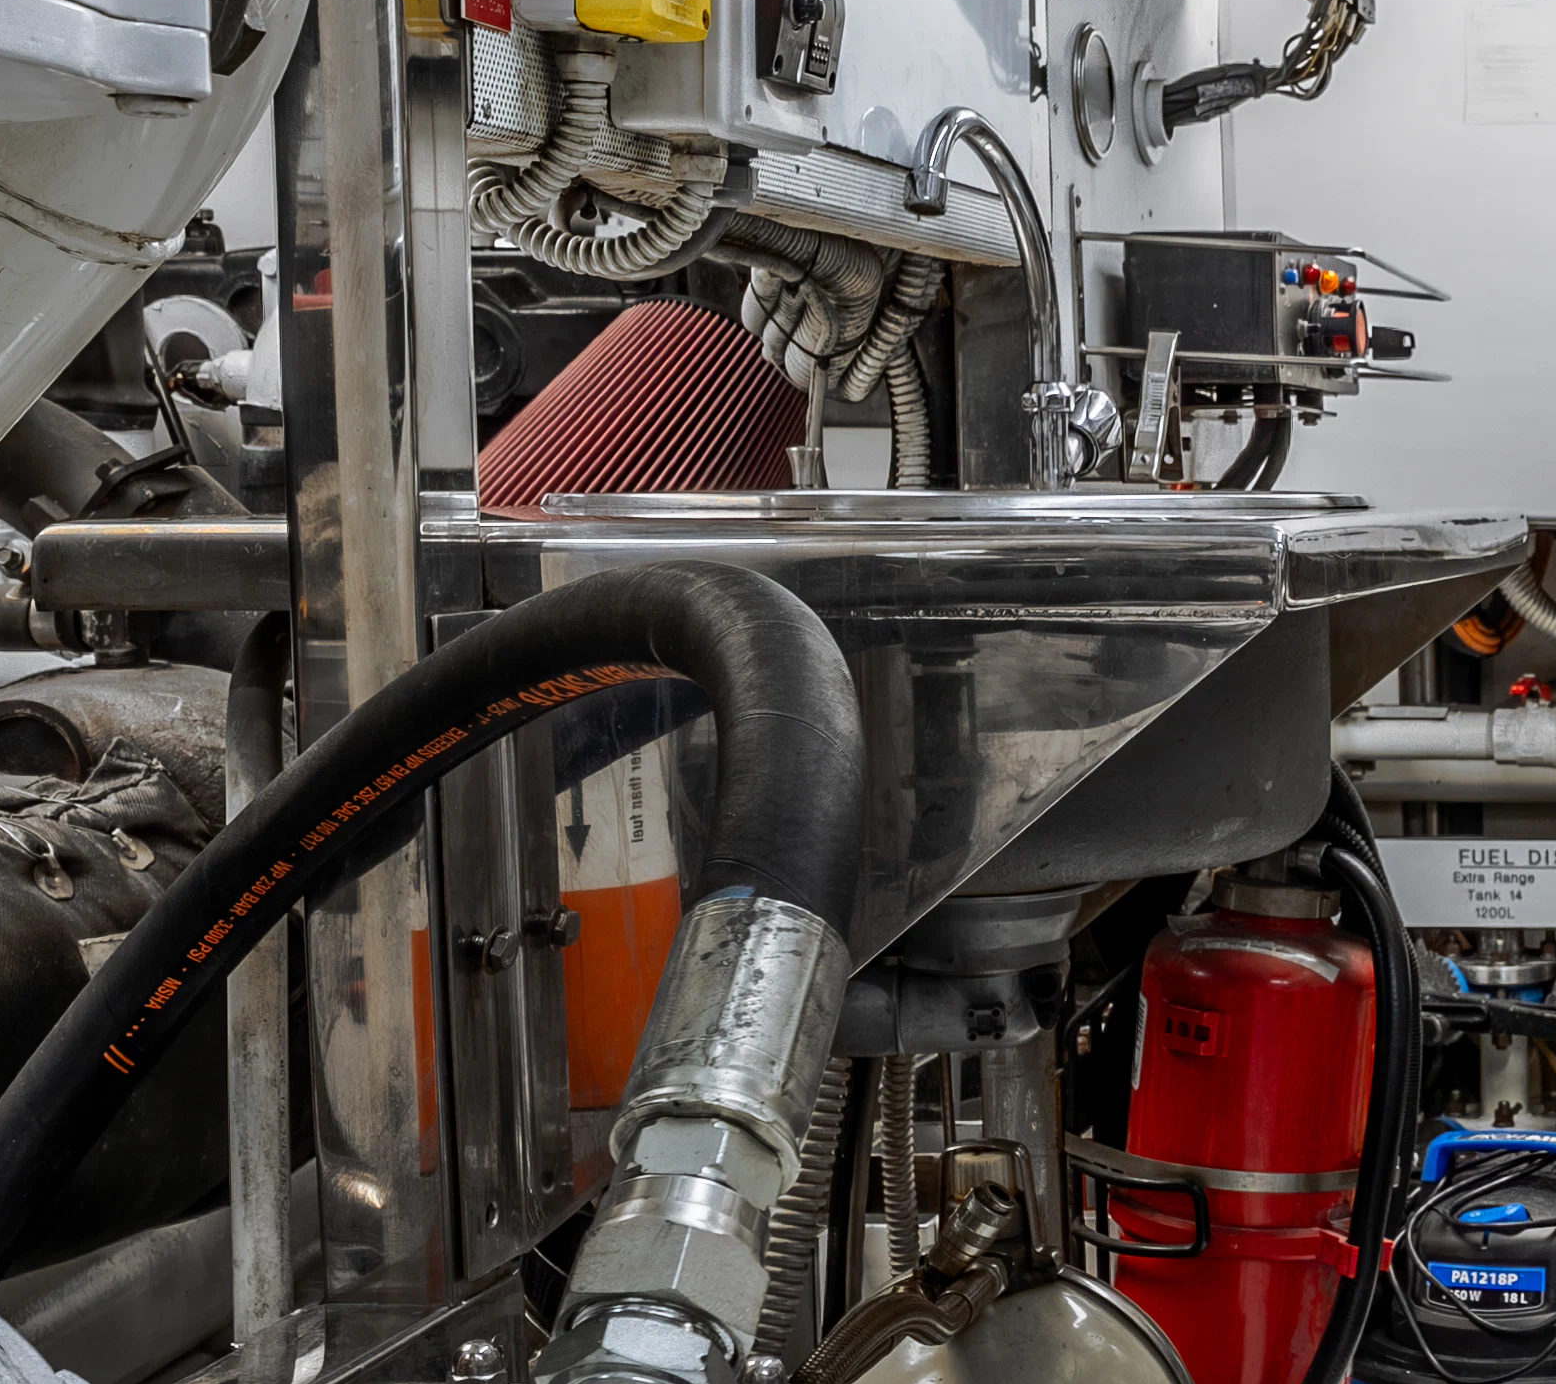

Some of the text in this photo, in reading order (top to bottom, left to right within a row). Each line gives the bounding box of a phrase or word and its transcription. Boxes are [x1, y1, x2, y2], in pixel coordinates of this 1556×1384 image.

[417, 727, 468, 758] EXCEEDS
[404, 754, 426, 769] WP
[388, 764, 411, 779] EN
[332, 801, 361, 821] SAE
[316, 819, 339, 835] 100
[300, 831, 325, 851] R17
[1458, 849, 1514, 865] FUEL
[270, 861, 293, 879] WP
[1453, 872, 1535, 885] Extra Range
[252, 876, 275, 895] 230
[1468, 889, 1522, 901] Tank 14
[230, 893, 260, 916] BAR
[1475, 907, 1514, 919] 1200L
[204, 919, 233, 944] 3300
[187, 942, 212, 962] PSI
[144, 977, 182, 1009] MSHA
[1451, 1270, 1518, 1286] PA1218P
